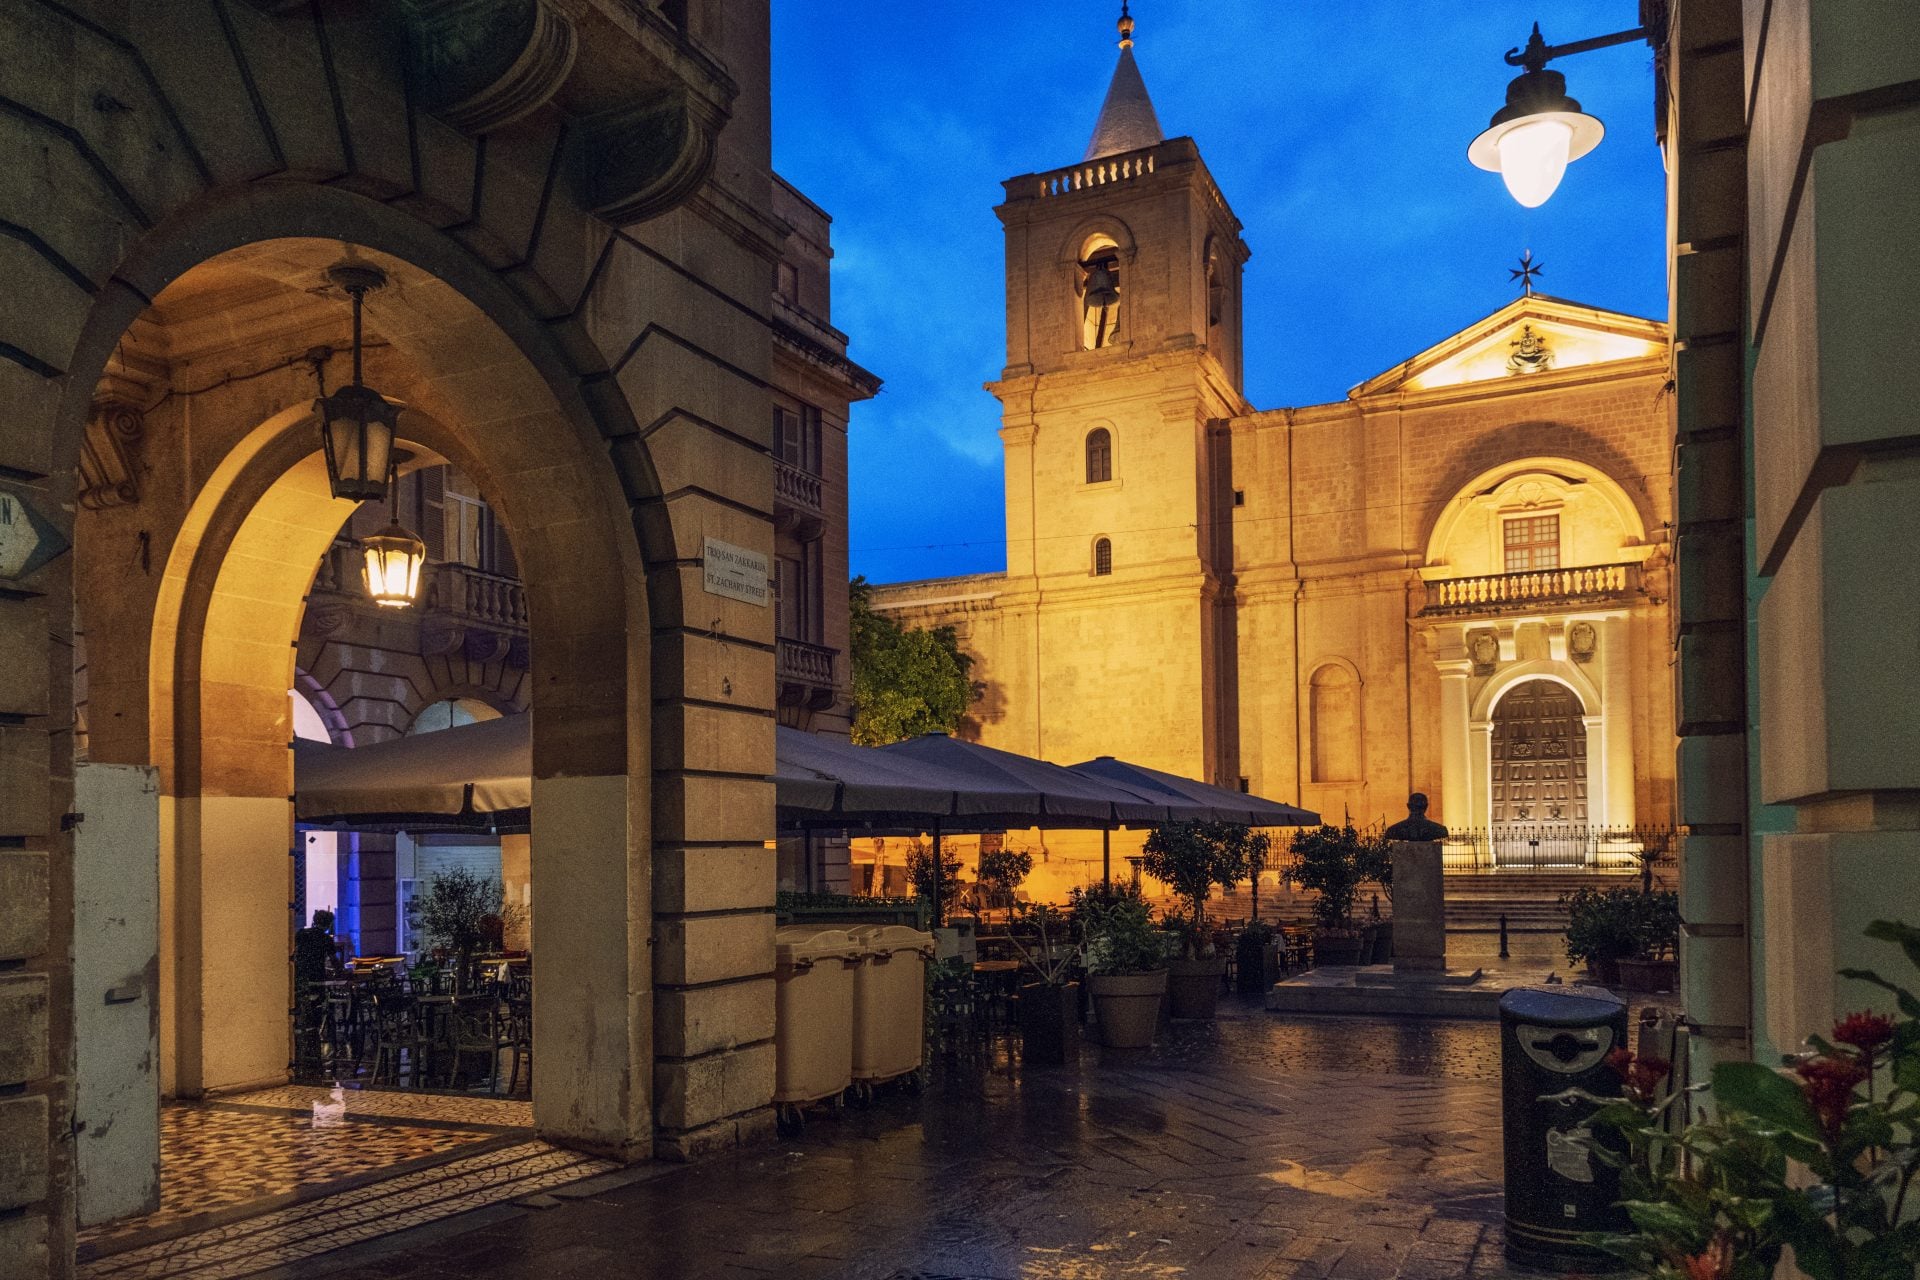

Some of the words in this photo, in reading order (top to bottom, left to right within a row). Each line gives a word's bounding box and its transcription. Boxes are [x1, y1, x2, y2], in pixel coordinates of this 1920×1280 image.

[706, 546, 720, 560] TRIQ
[722, 551, 734, 563] SAN
[706, 573, 716, 585] ST.
[716, 576, 744, 593] ZACHARY
[745, 584, 765, 598] STREET
